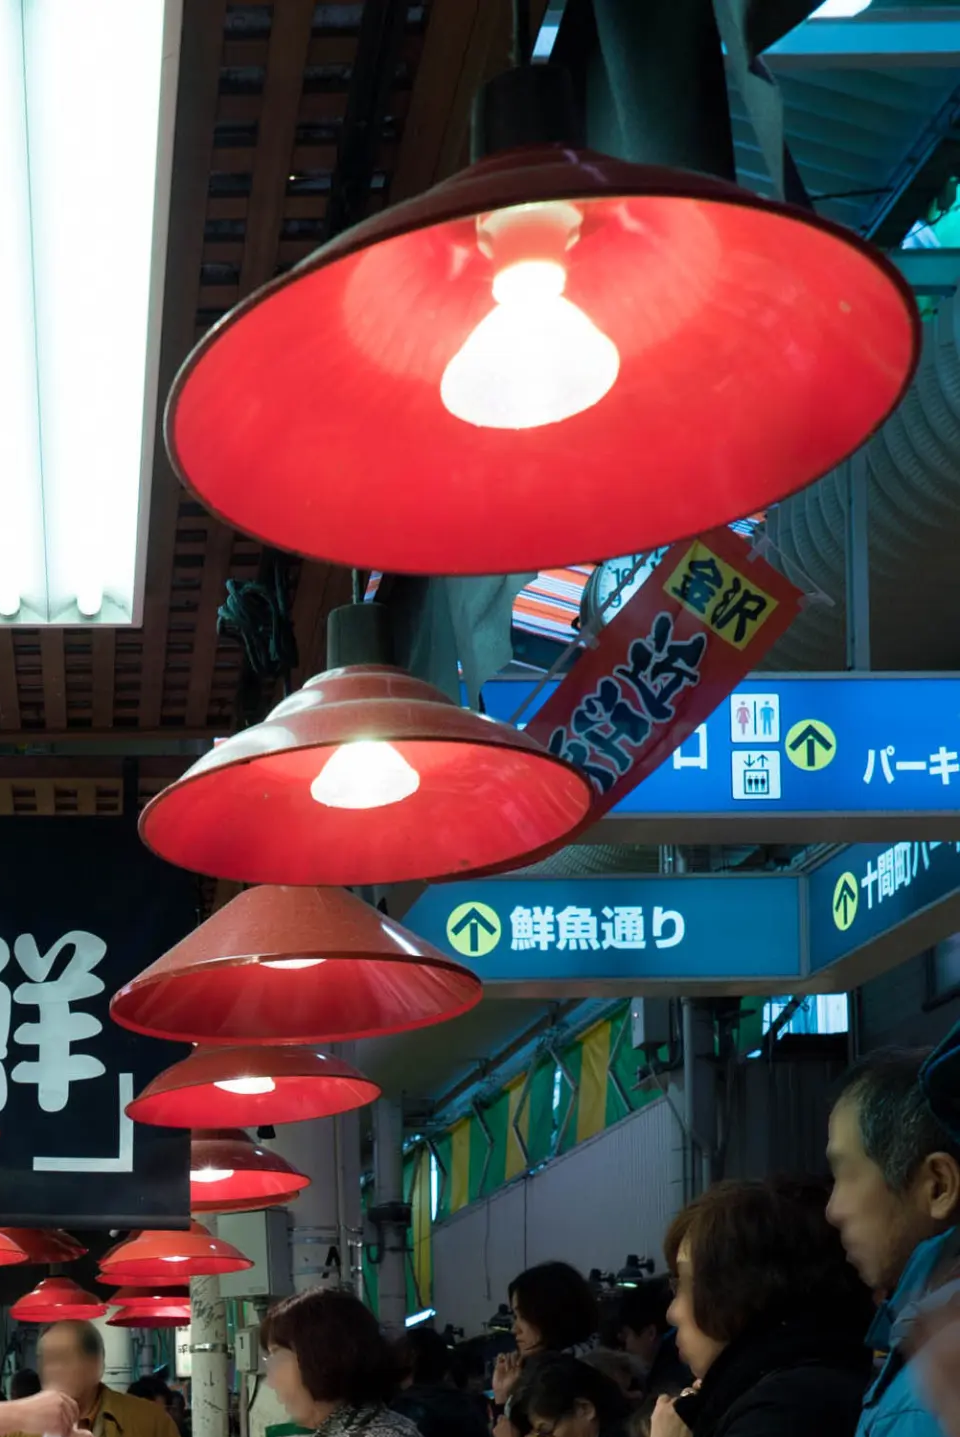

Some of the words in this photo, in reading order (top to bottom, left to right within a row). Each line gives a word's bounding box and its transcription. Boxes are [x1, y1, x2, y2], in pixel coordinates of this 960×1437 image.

[670, 557, 767, 643] 金沢
[509, 905, 685, 951] 鮮魚通り
